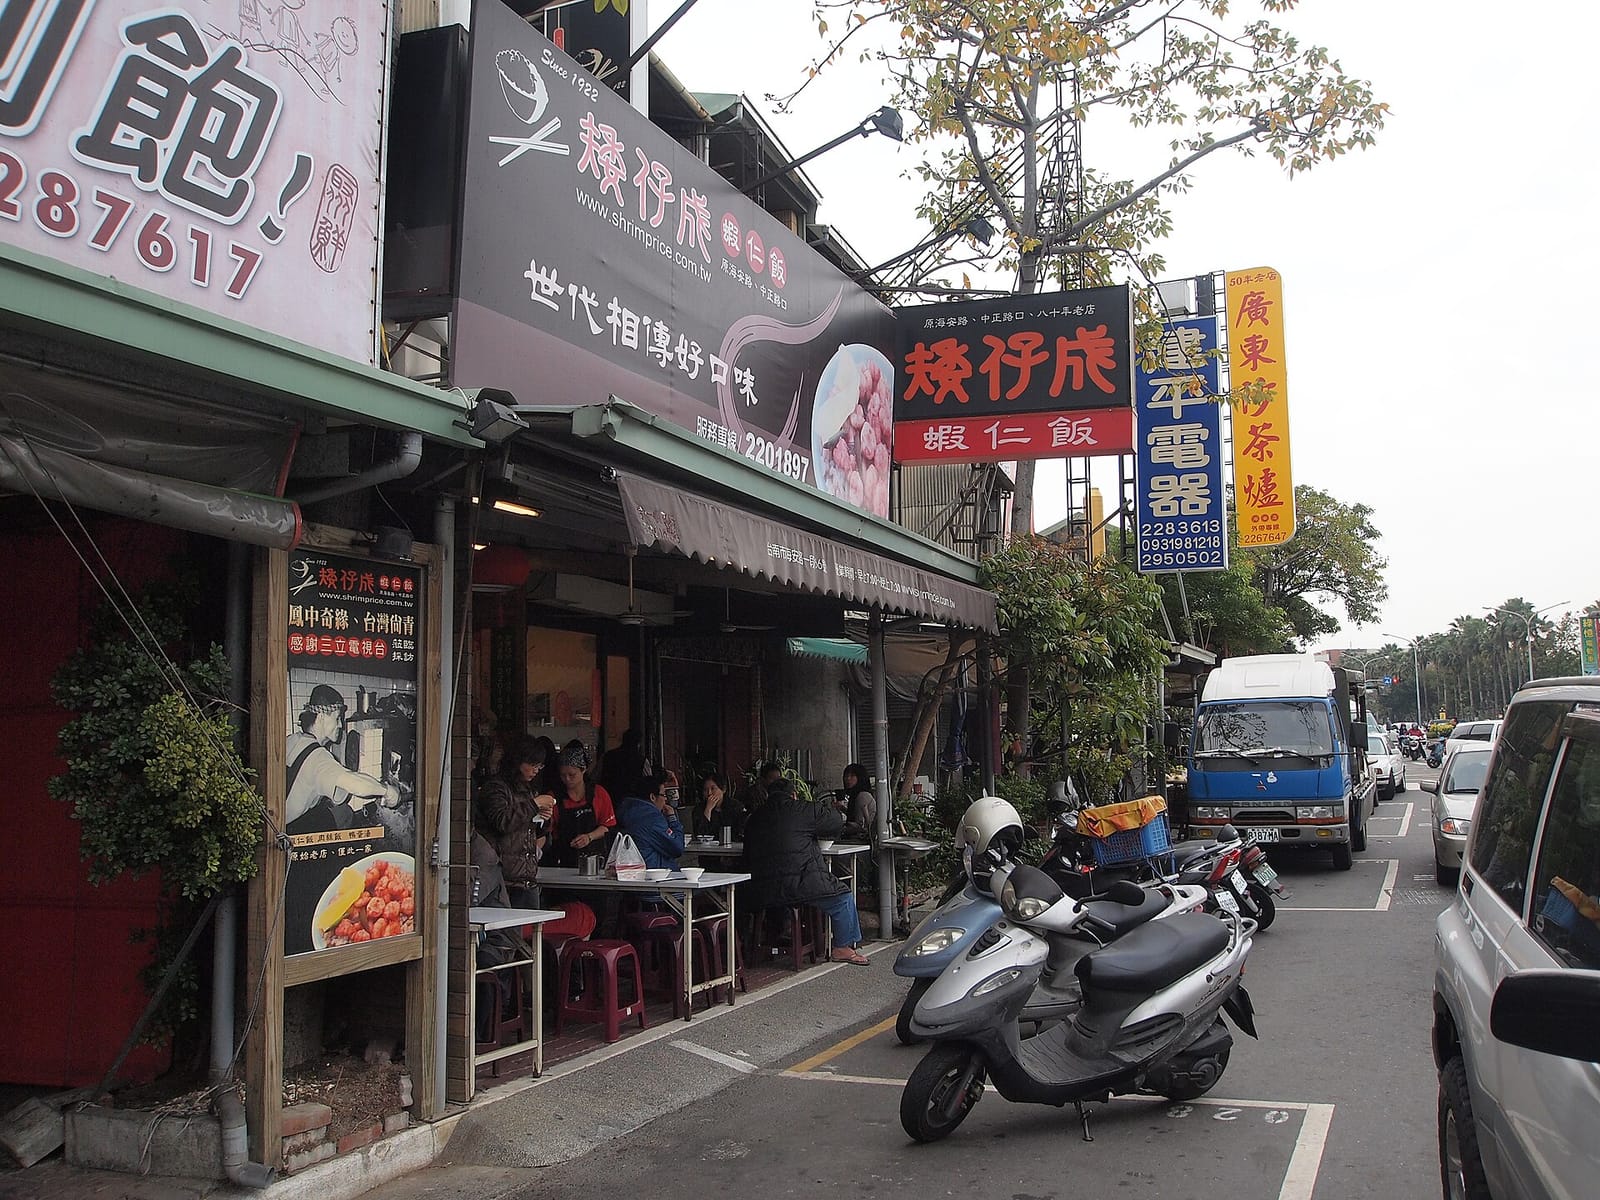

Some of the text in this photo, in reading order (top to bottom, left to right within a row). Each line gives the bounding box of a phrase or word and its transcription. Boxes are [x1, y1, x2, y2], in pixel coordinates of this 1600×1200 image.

[541, 48, 599, 103] Since 1922
[0, 0, 313, 244] 飽!
[575, 187, 712, 284] www.shrimprice.com.tw
[722, 216, 787, 288] 蝦仁飯
[1229, 271, 1278, 287] 50年老店
[524, 258, 759, 407] 世代相傳好口味
[922, 415, 1099, 453] 蝦仁飯
[745, 432, 810, 484] 2201897
[1142, 520, 1220, 536] 2283613
[1244, 532, 1287, 544] 2267647
[1142, 536, 1220, 551] 0931981218
[1142, 551, 1221, 567] 2950502
[318, 591, 414, 608] www.shrimprice.com.tw
[290, 635, 386, 657] 感謝三立電視台
